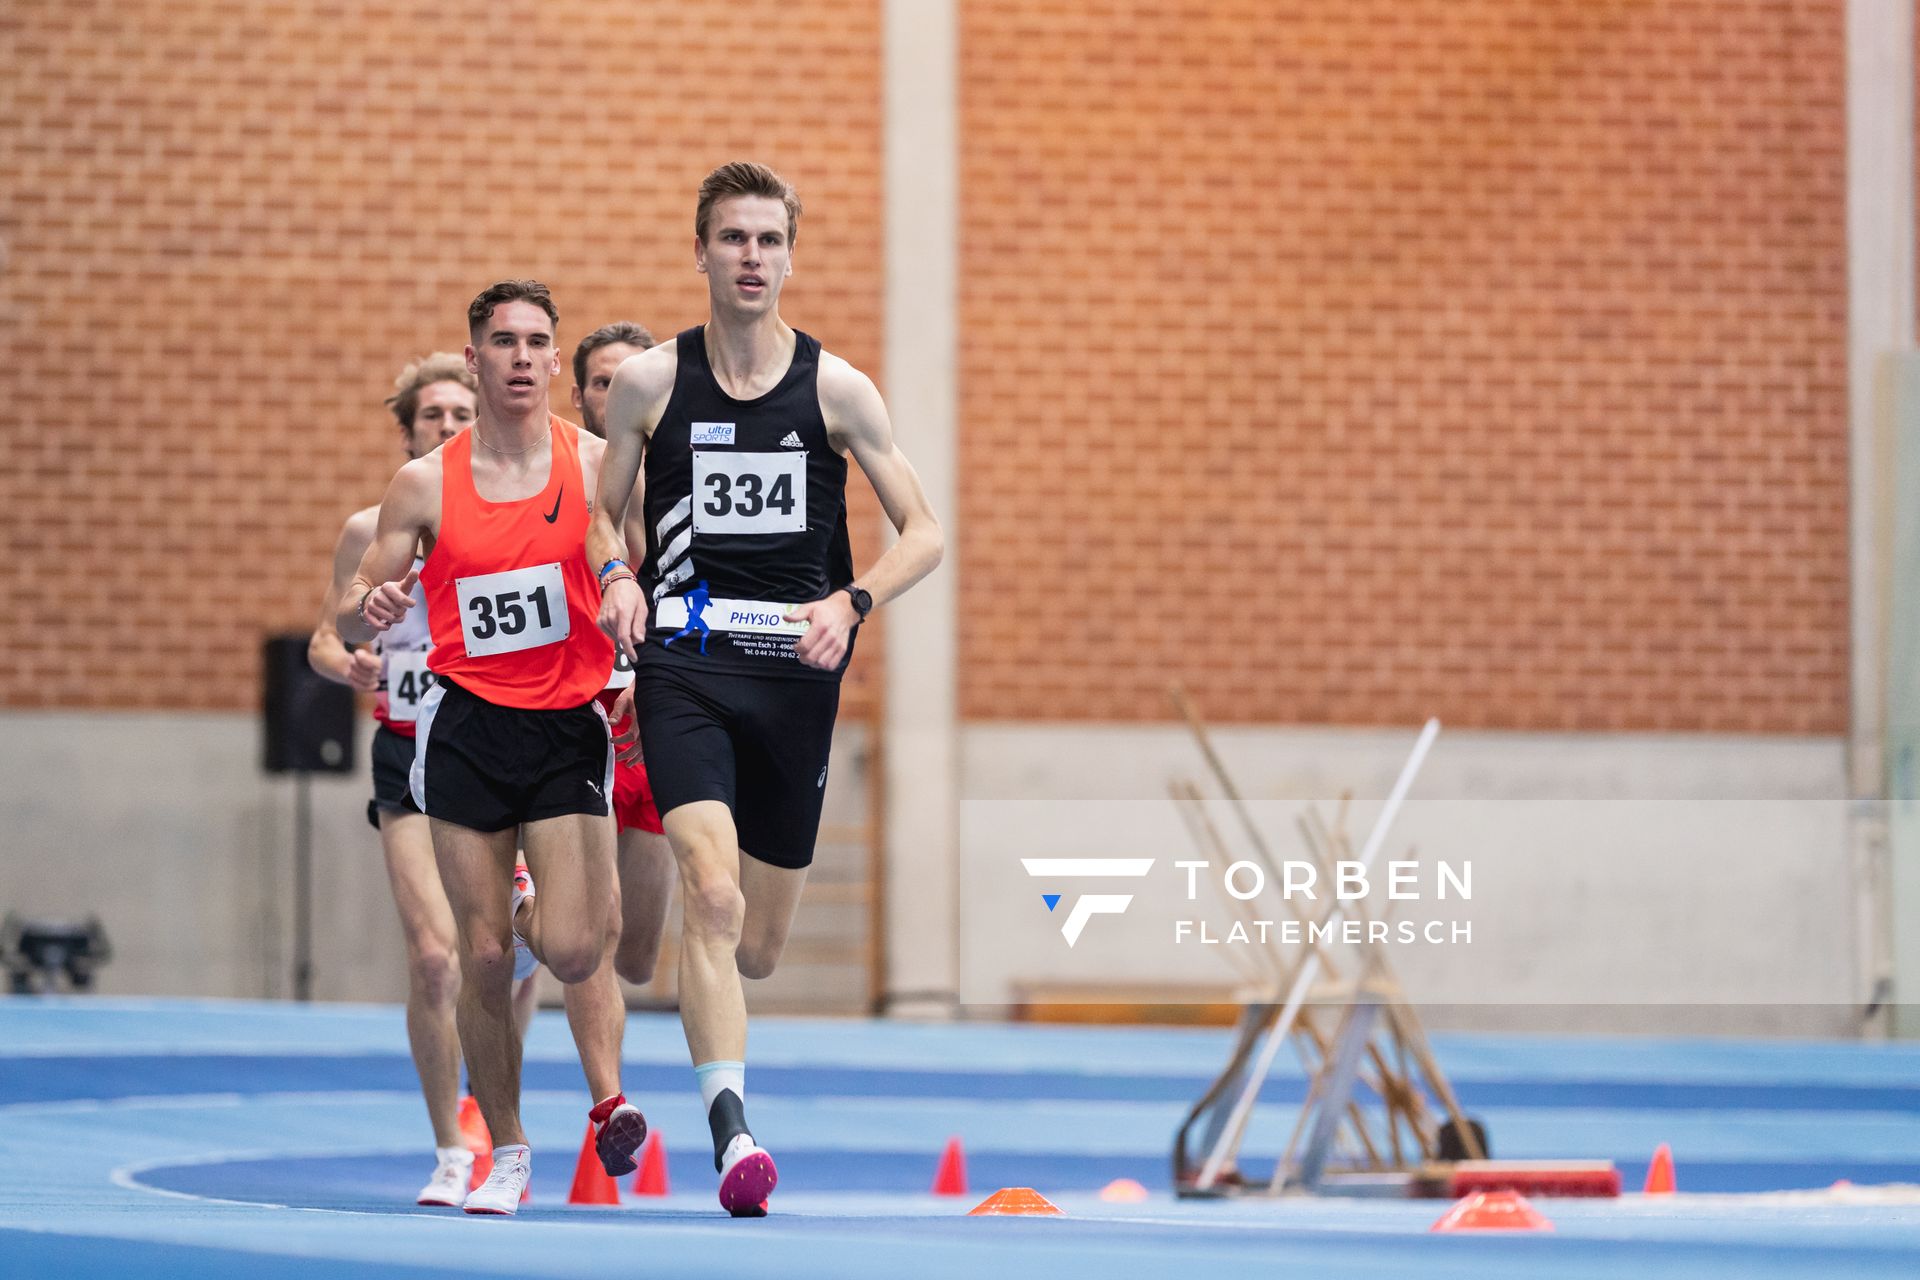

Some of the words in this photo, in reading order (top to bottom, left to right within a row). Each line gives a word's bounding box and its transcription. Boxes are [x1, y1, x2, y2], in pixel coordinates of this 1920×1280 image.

[708, 425, 732, 435] ultra
[693, 434, 730, 442] SPORTS
[780, 440, 804, 448] adidas
[704, 472, 795, 517] 334
[468, 585, 552, 640] 351
[730, 612, 780, 626] PHYSIO
[744, 648, 754, 656] Tel.
